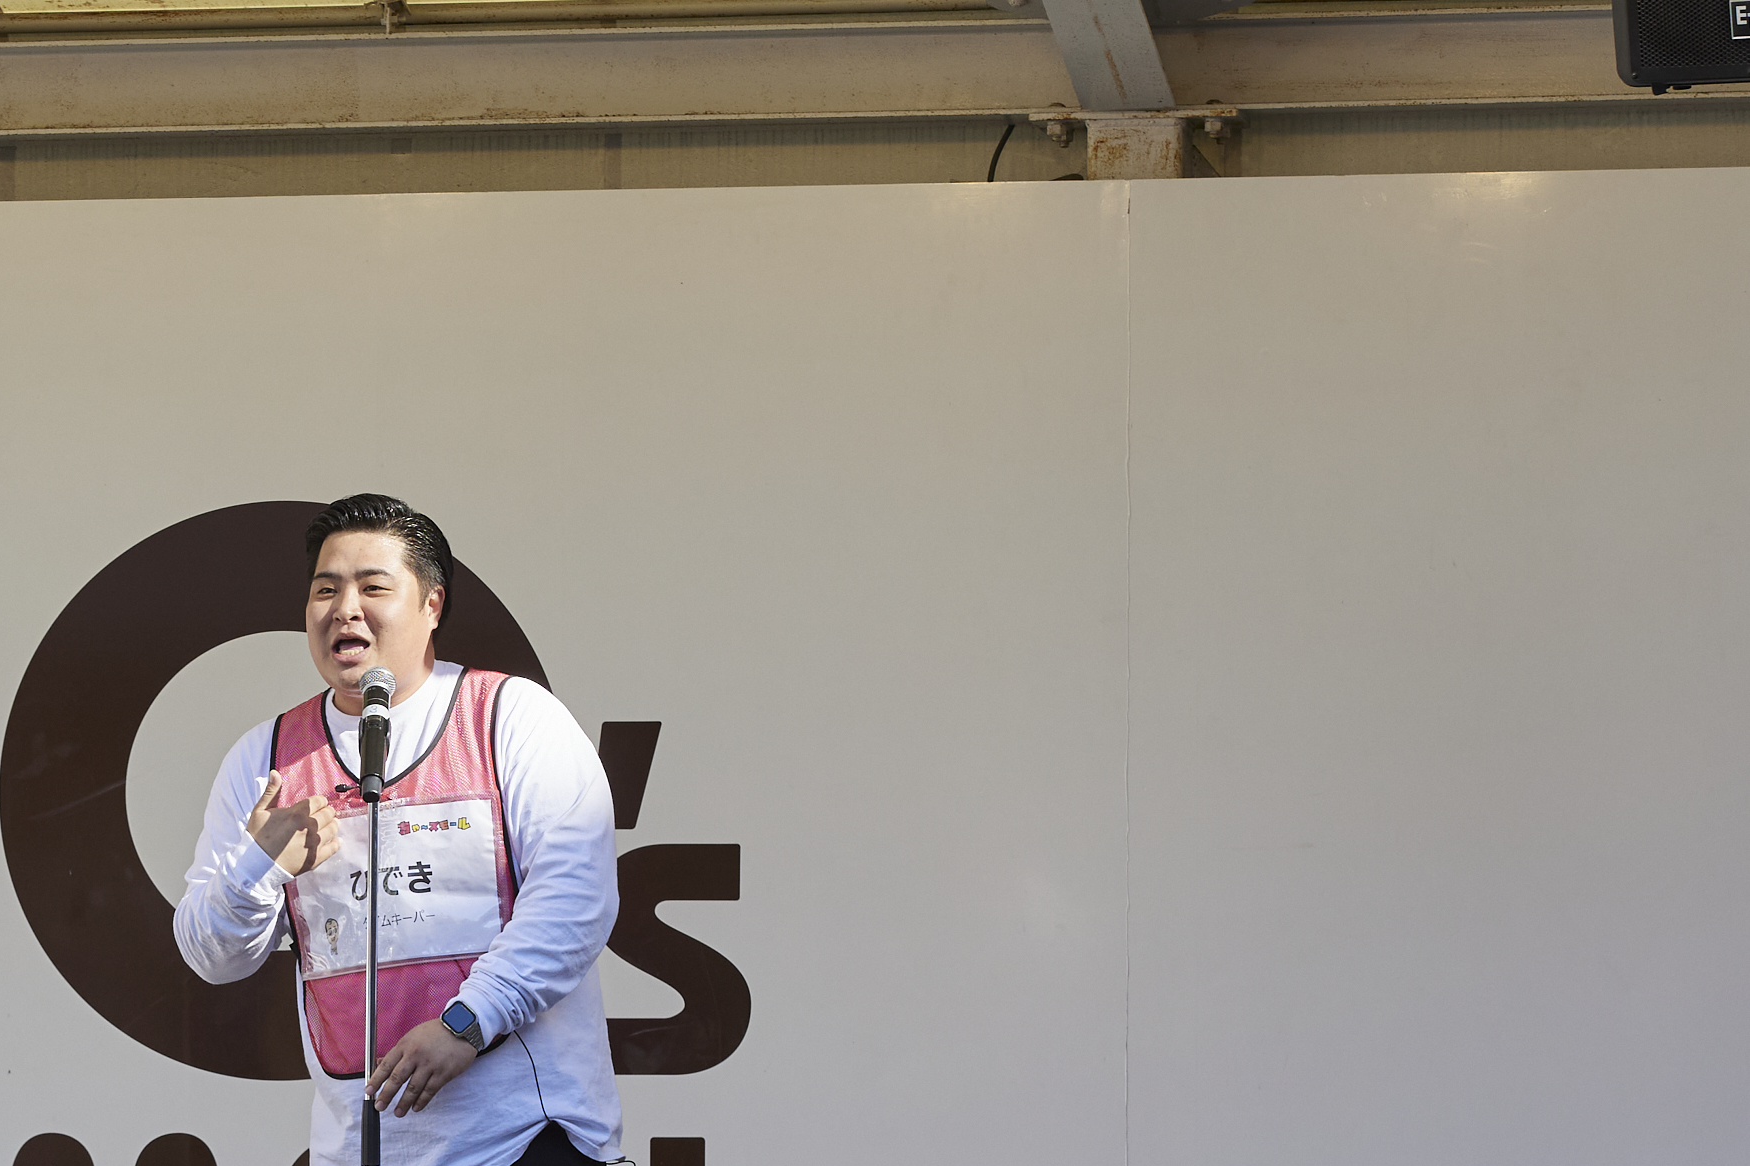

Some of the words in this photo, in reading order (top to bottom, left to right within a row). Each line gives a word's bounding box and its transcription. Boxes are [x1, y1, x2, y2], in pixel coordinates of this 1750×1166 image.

[1735, 5, 1750, 26] E
[350, 860, 433, 901] ひでき
[362, 908, 436, 930] ムキーパー
